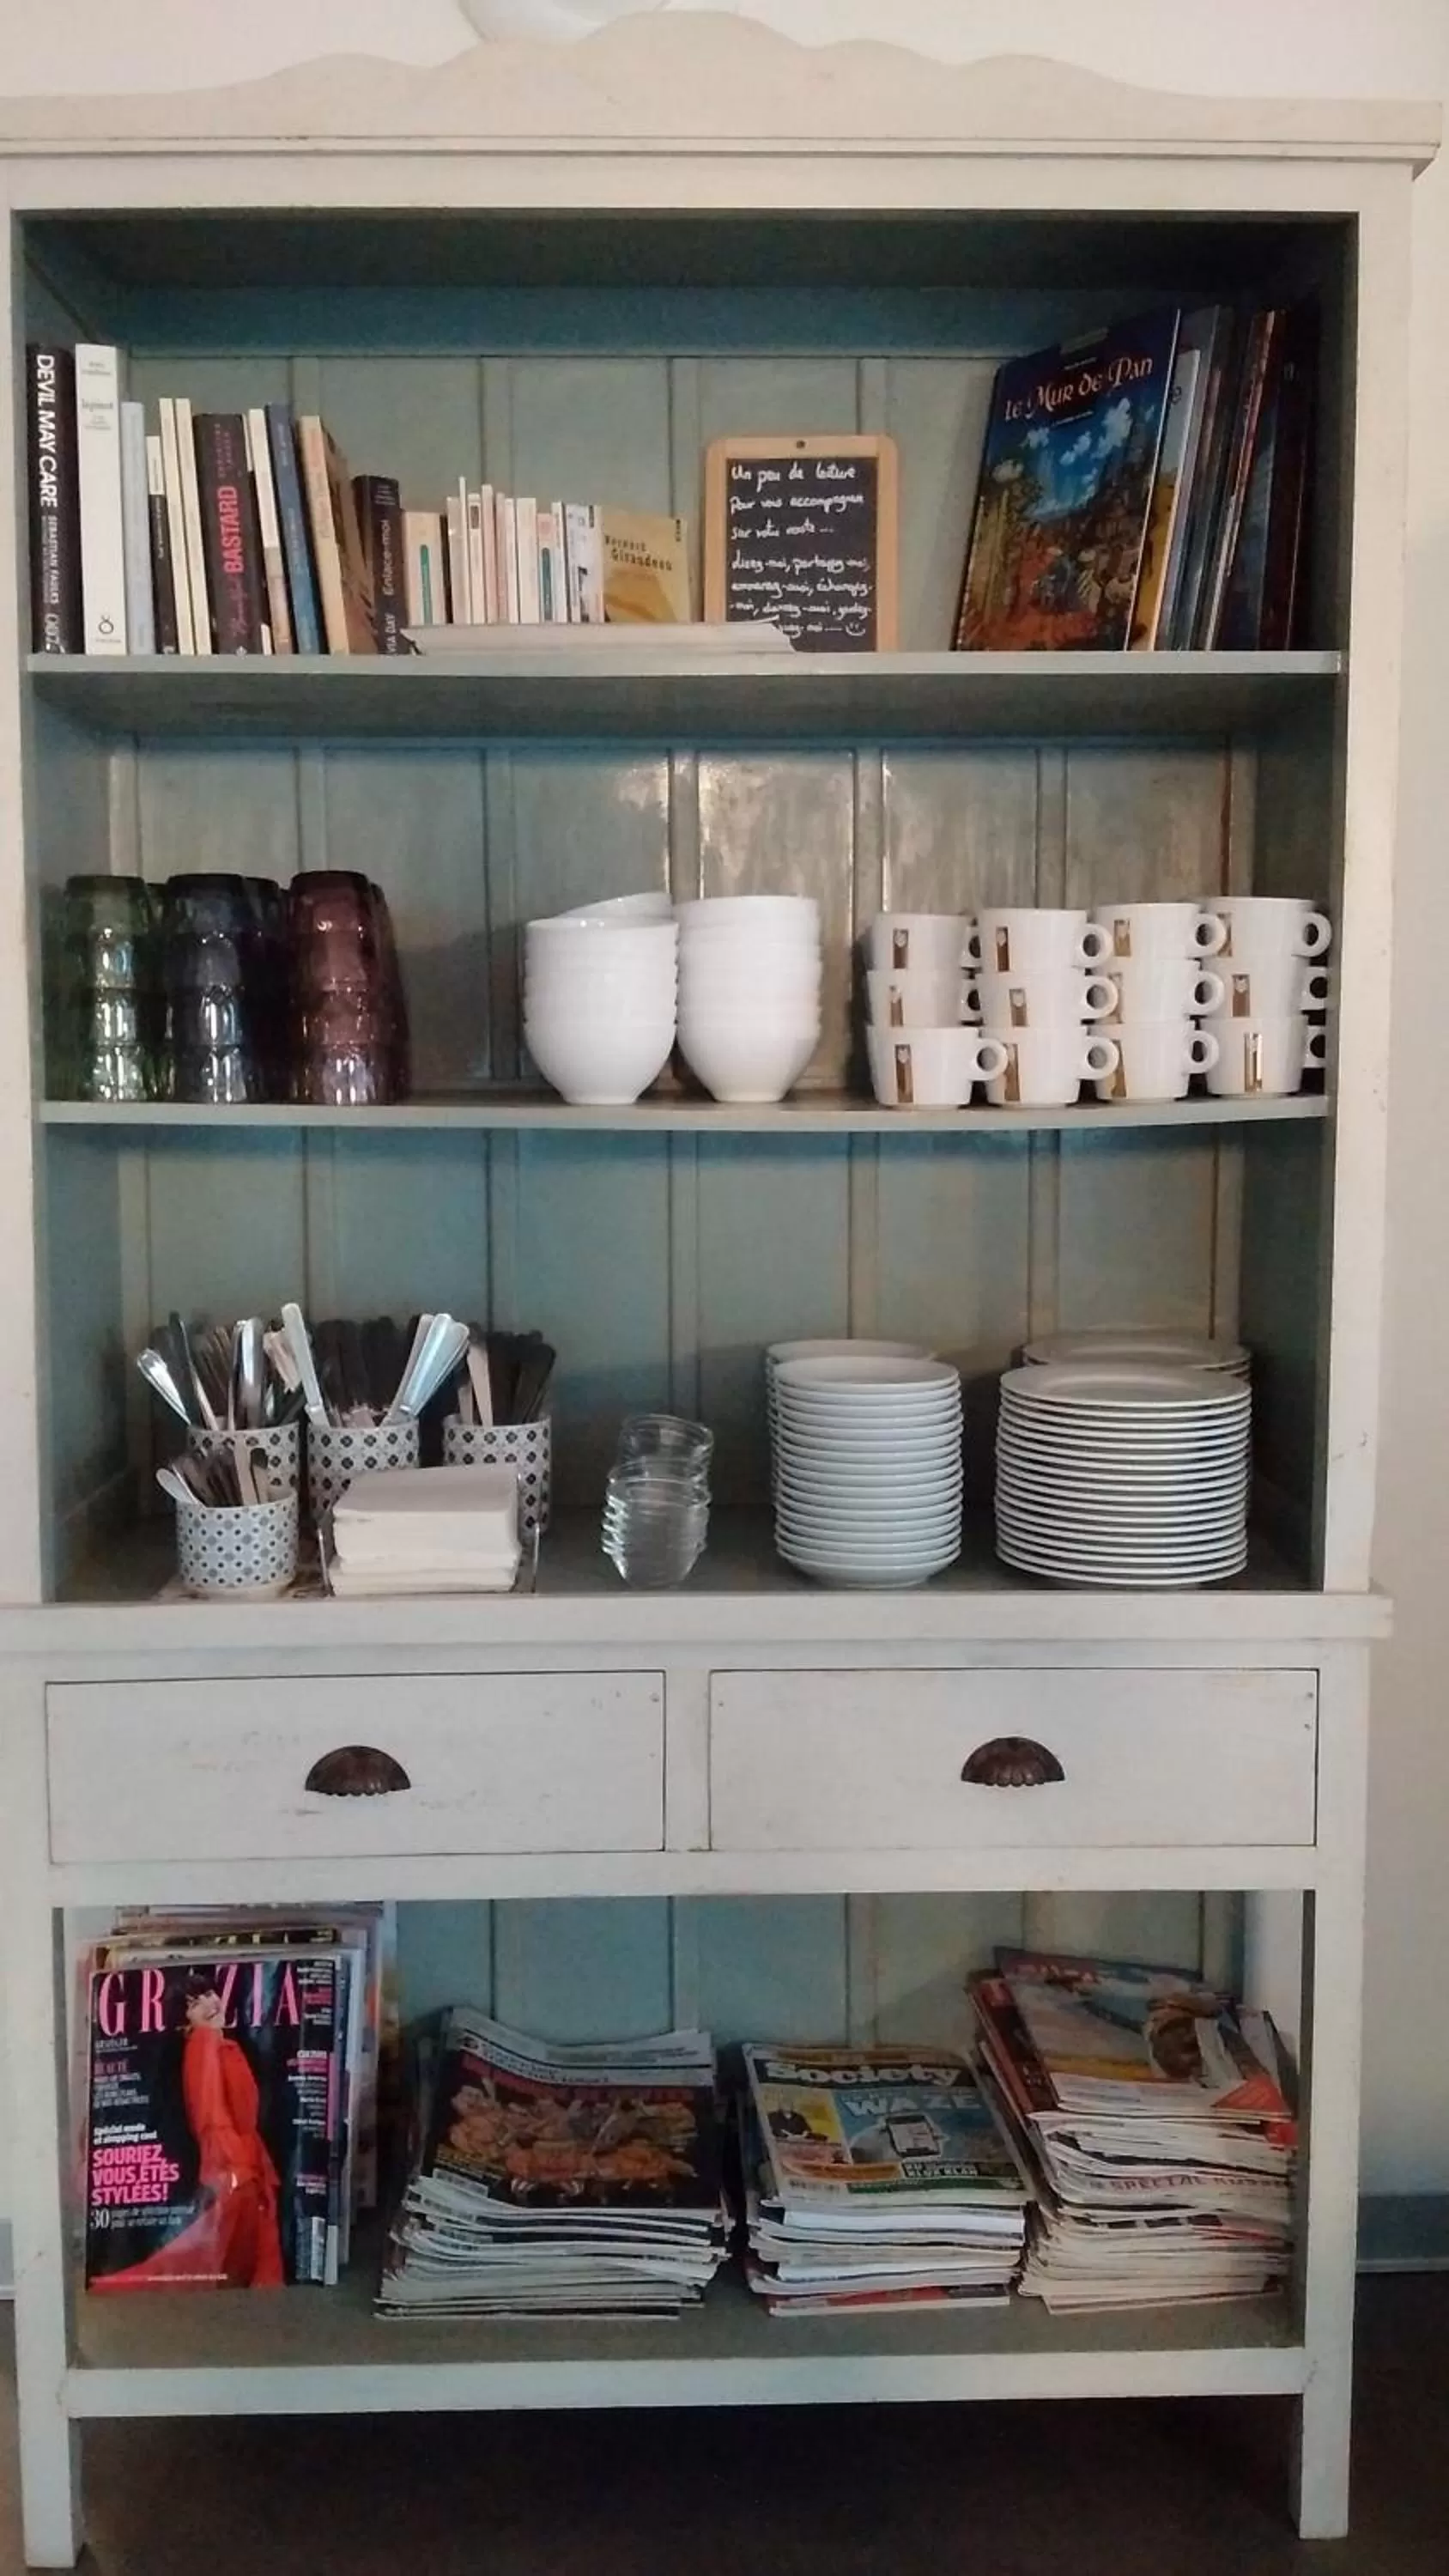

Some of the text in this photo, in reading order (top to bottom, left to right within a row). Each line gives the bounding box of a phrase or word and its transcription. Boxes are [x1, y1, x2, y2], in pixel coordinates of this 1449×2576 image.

[36, 355, 55, 406] DEVIL
[38, 410, 57, 453] MAY
[39, 455, 58, 508] CARE
[788, 461, 804, 480] de
[217, 485, 245, 574] BASTARD
[99, 1961, 300, 2037] GRZIA
[92, 2166, 137, 2187] VOUS
[90, 2208, 110, 2230] 30
